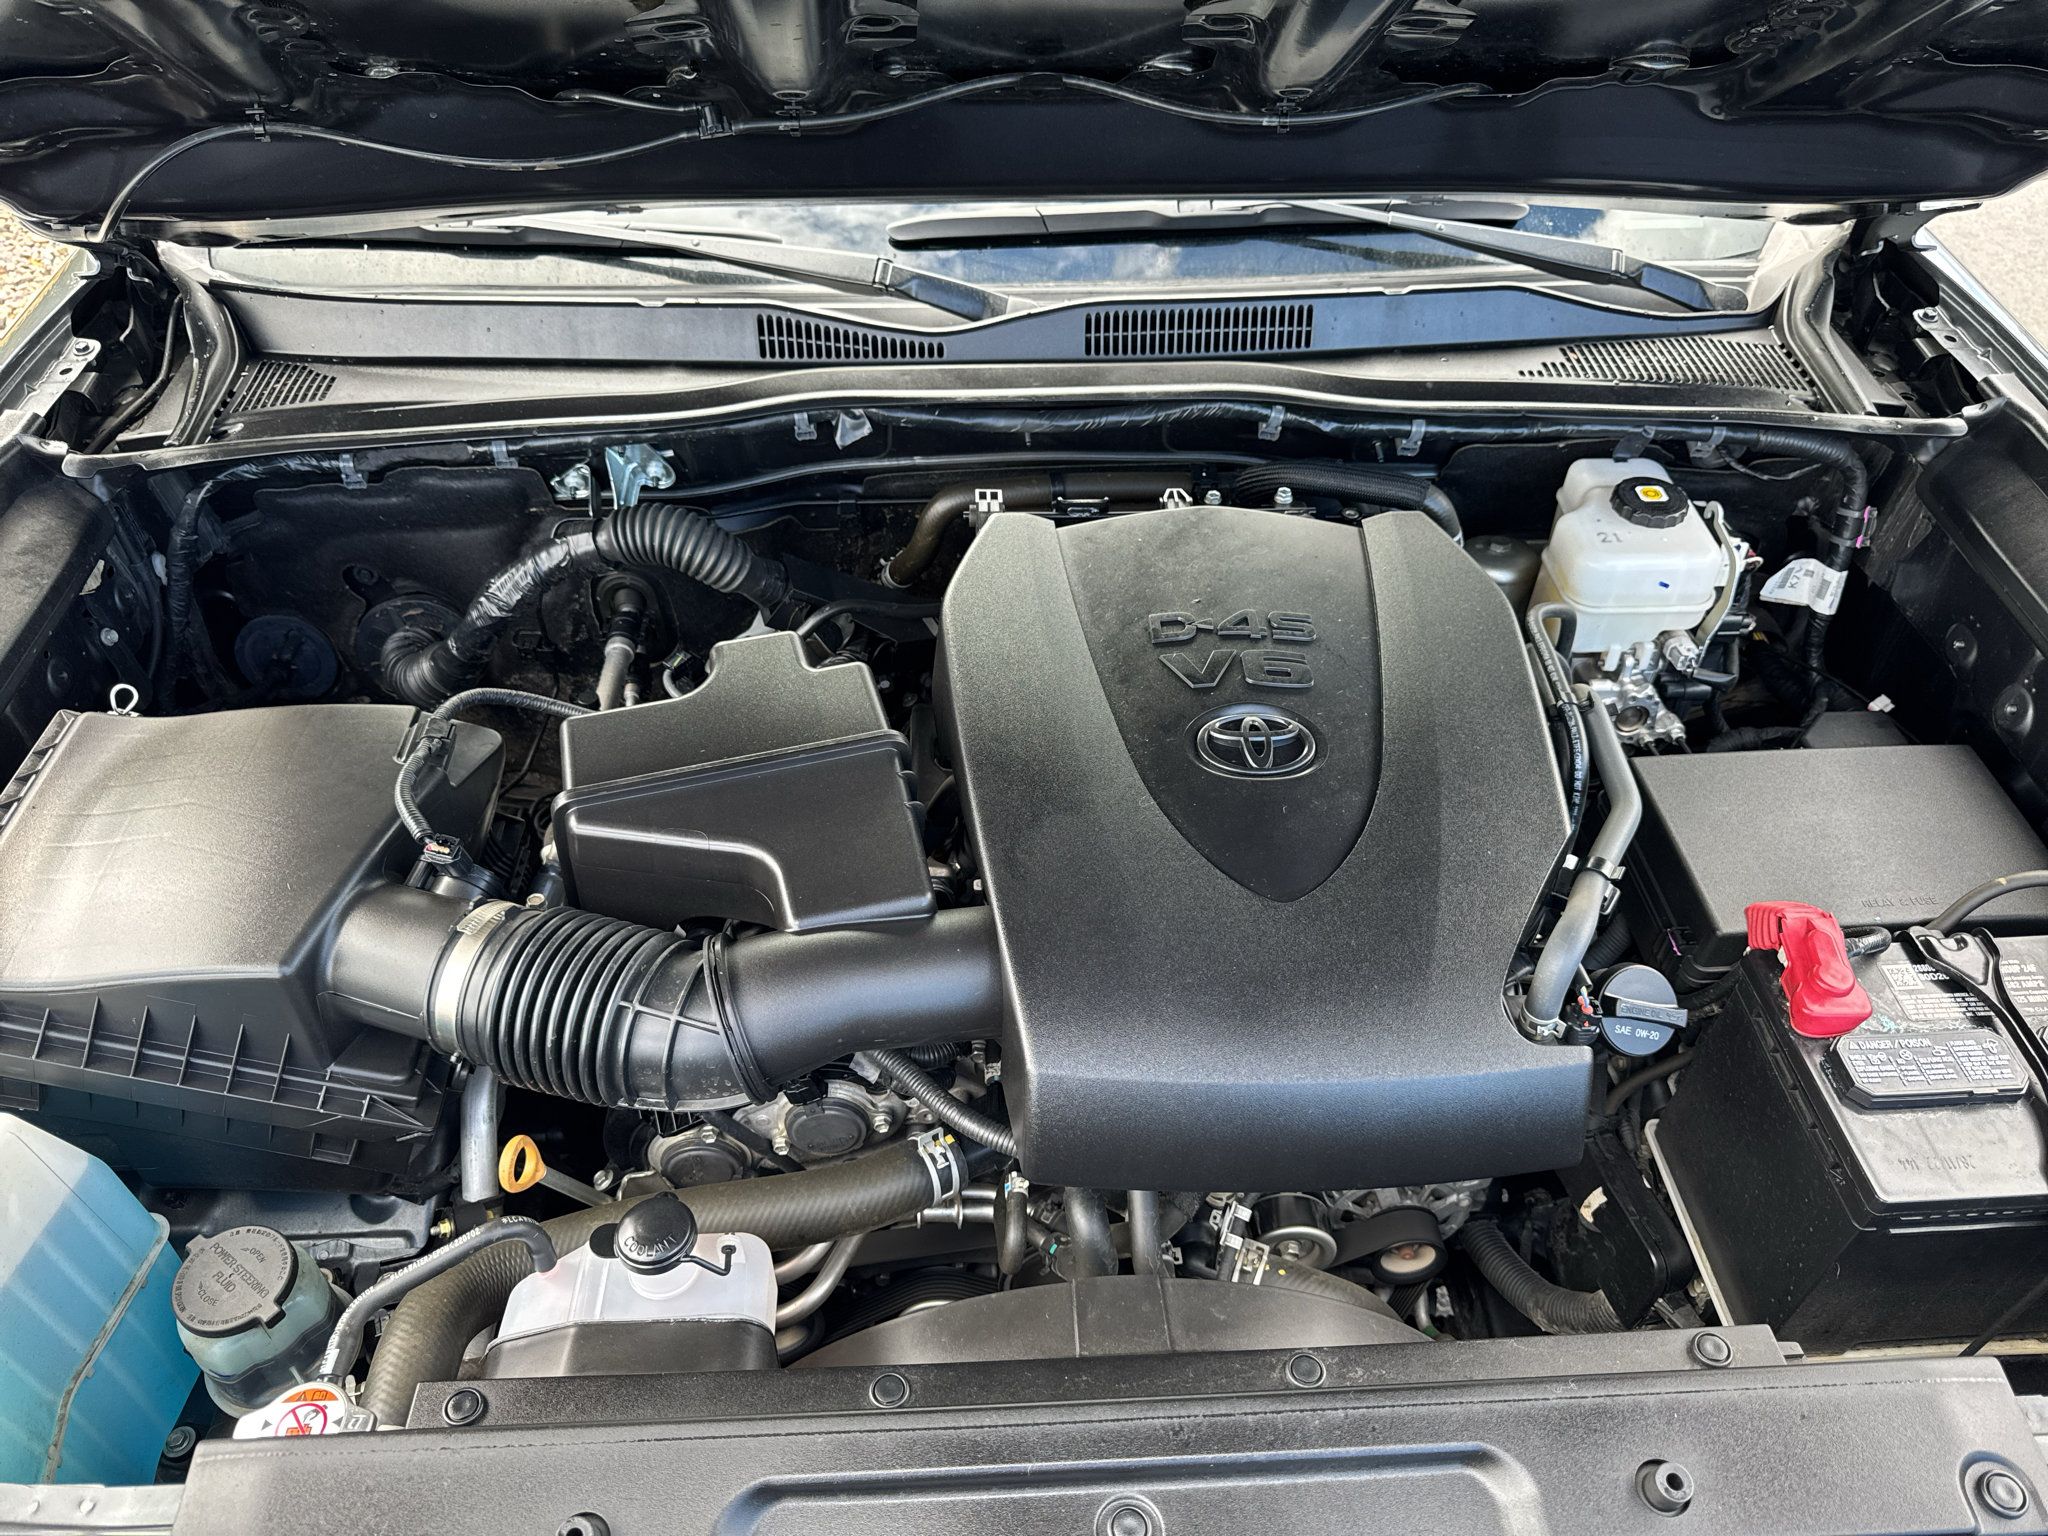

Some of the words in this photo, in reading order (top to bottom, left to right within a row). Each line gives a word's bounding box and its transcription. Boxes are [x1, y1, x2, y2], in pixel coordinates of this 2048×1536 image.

[1149, 608, 1317, 644] D-4S
[1158, 649, 1315, 689] V6
[1620, 1003, 1651, 1017] ENGINE
[1614, 1024, 1632, 1036] SAE
[1635, 1028, 1660, 1040] 0W-20
[1858, 1039, 1894, 1050] DANGER
[1899, 1038, 1932, 1048] POISON
[623, 1233, 677, 1258] COOLANT
[249, 1247, 267, 1265] OPEN
[209, 1242, 238, 1271] POWER
[232, 1264, 270, 1300] STEERING
[211, 1271, 237, 1293] FLUID
[197, 1289, 219, 1307] CLOSE
